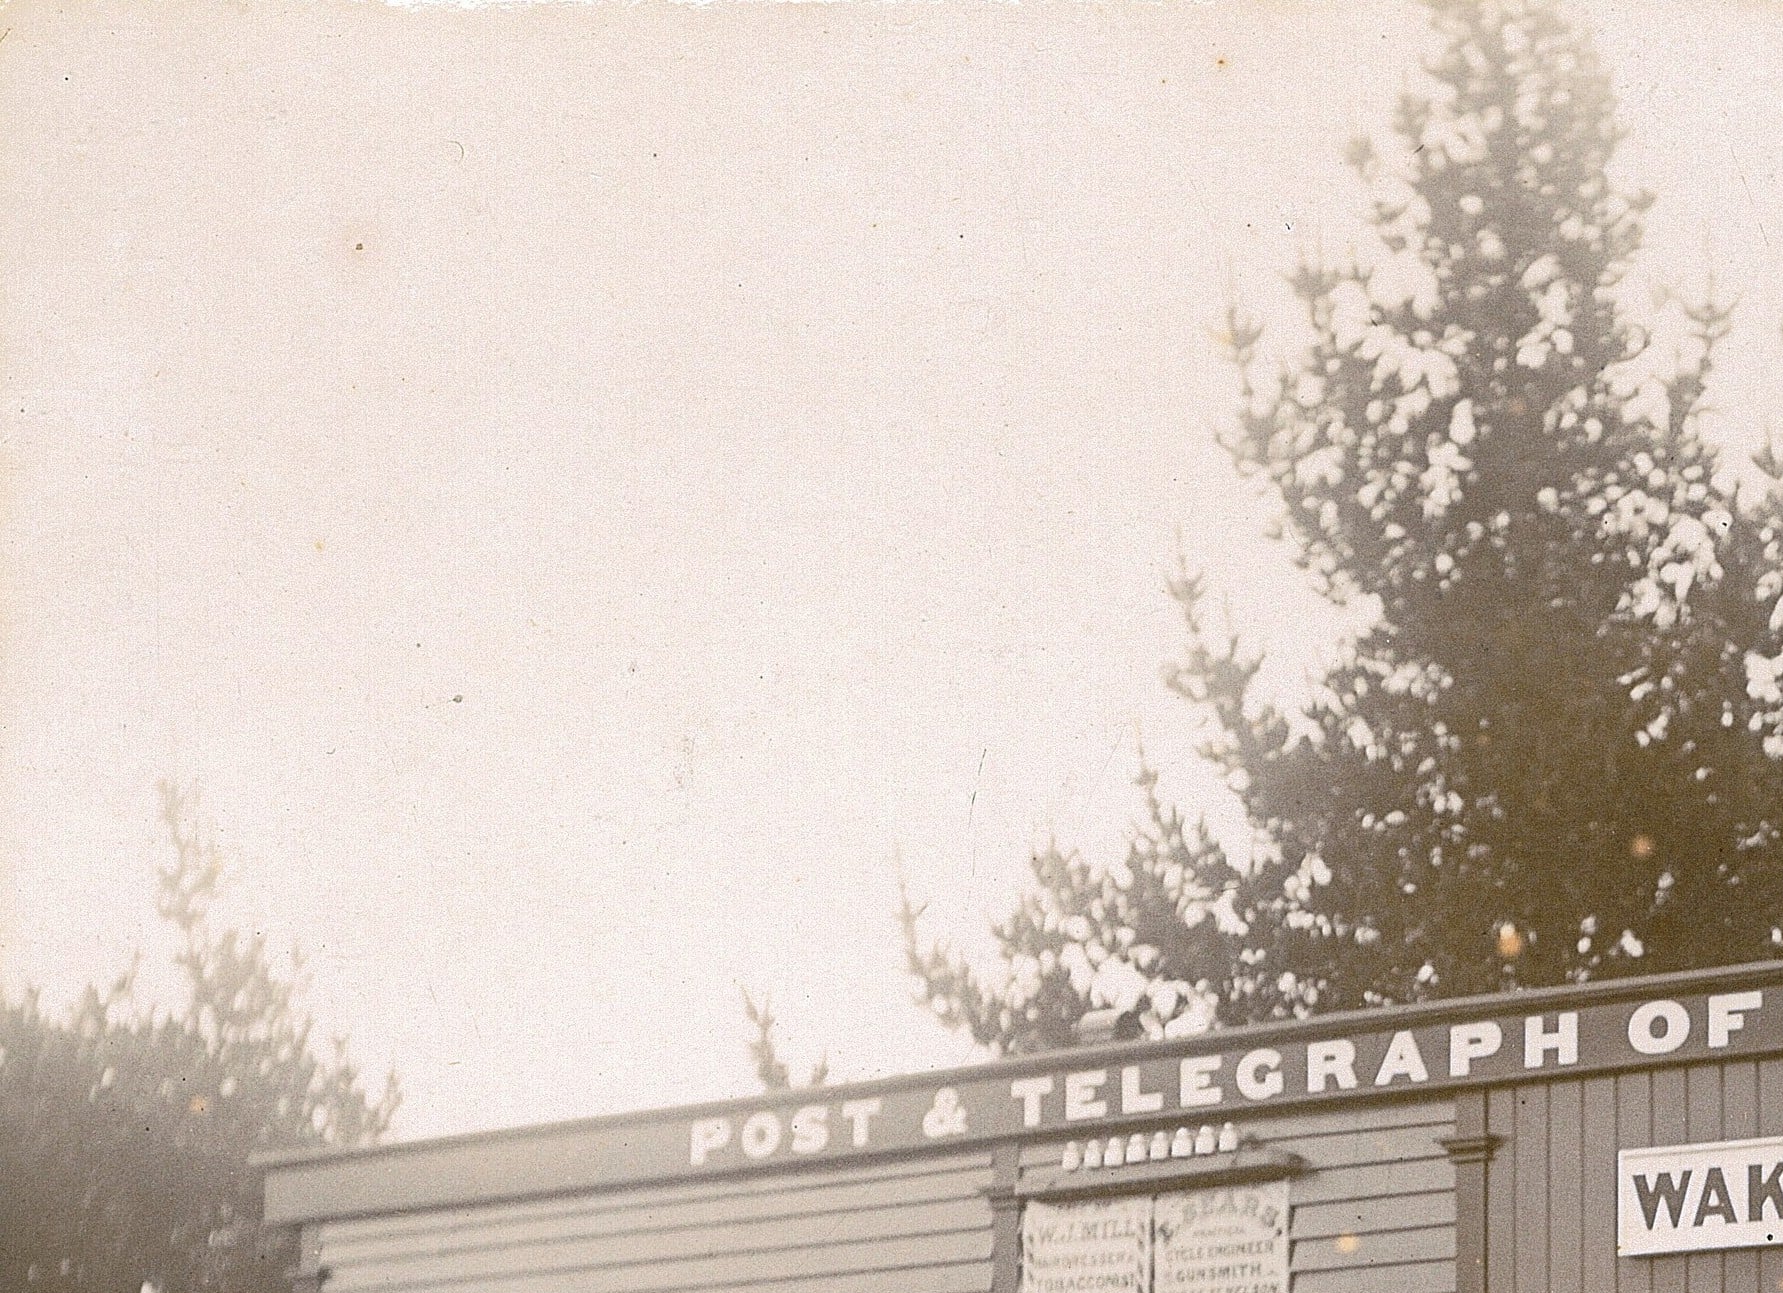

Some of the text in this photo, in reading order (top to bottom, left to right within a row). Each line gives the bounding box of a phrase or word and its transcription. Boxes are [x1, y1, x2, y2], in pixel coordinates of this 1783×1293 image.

[690, 1097, 882, 1166] POST
[922, 1087, 967, 1139] &
[1011, 1012, 1578, 1128] TELEGRAPH
[1176, 1263, 1261, 1282] GUNSMITH
